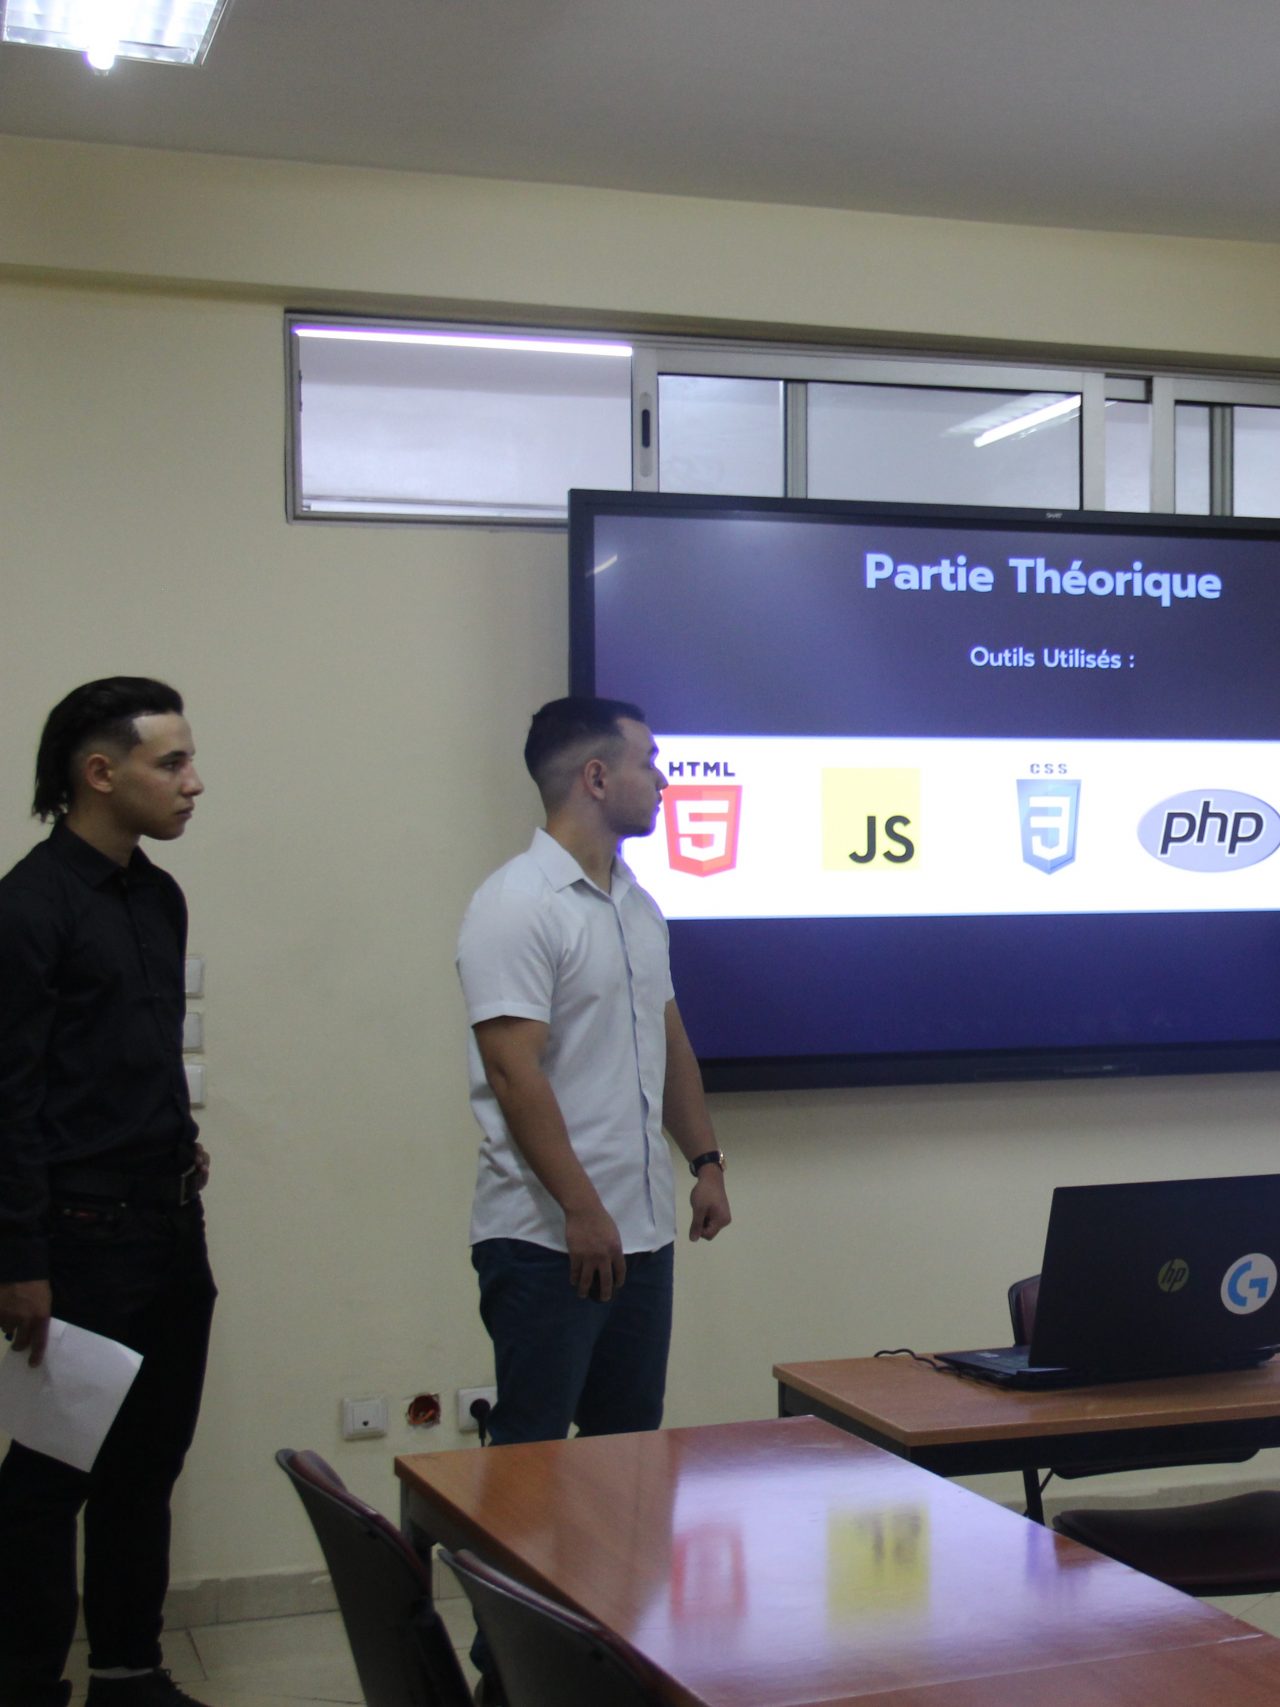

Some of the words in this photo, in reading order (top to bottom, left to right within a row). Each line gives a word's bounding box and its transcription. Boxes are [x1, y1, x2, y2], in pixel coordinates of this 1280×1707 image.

[865, 553, 994, 592] Partie
[1008, 557, 1222, 607] Théorique
[970, 646, 1035, 668] Outils
[1043, 647, 1121, 669] Utilisés
[668, 761, 735, 777] HTML
[1030, 763, 1068, 774] CSS
[675, 800, 729, 862] 5
[849, 815, 915, 864] JS
[1159, 800, 1264, 856] php
[1163, 1260, 1186, 1292] hp
